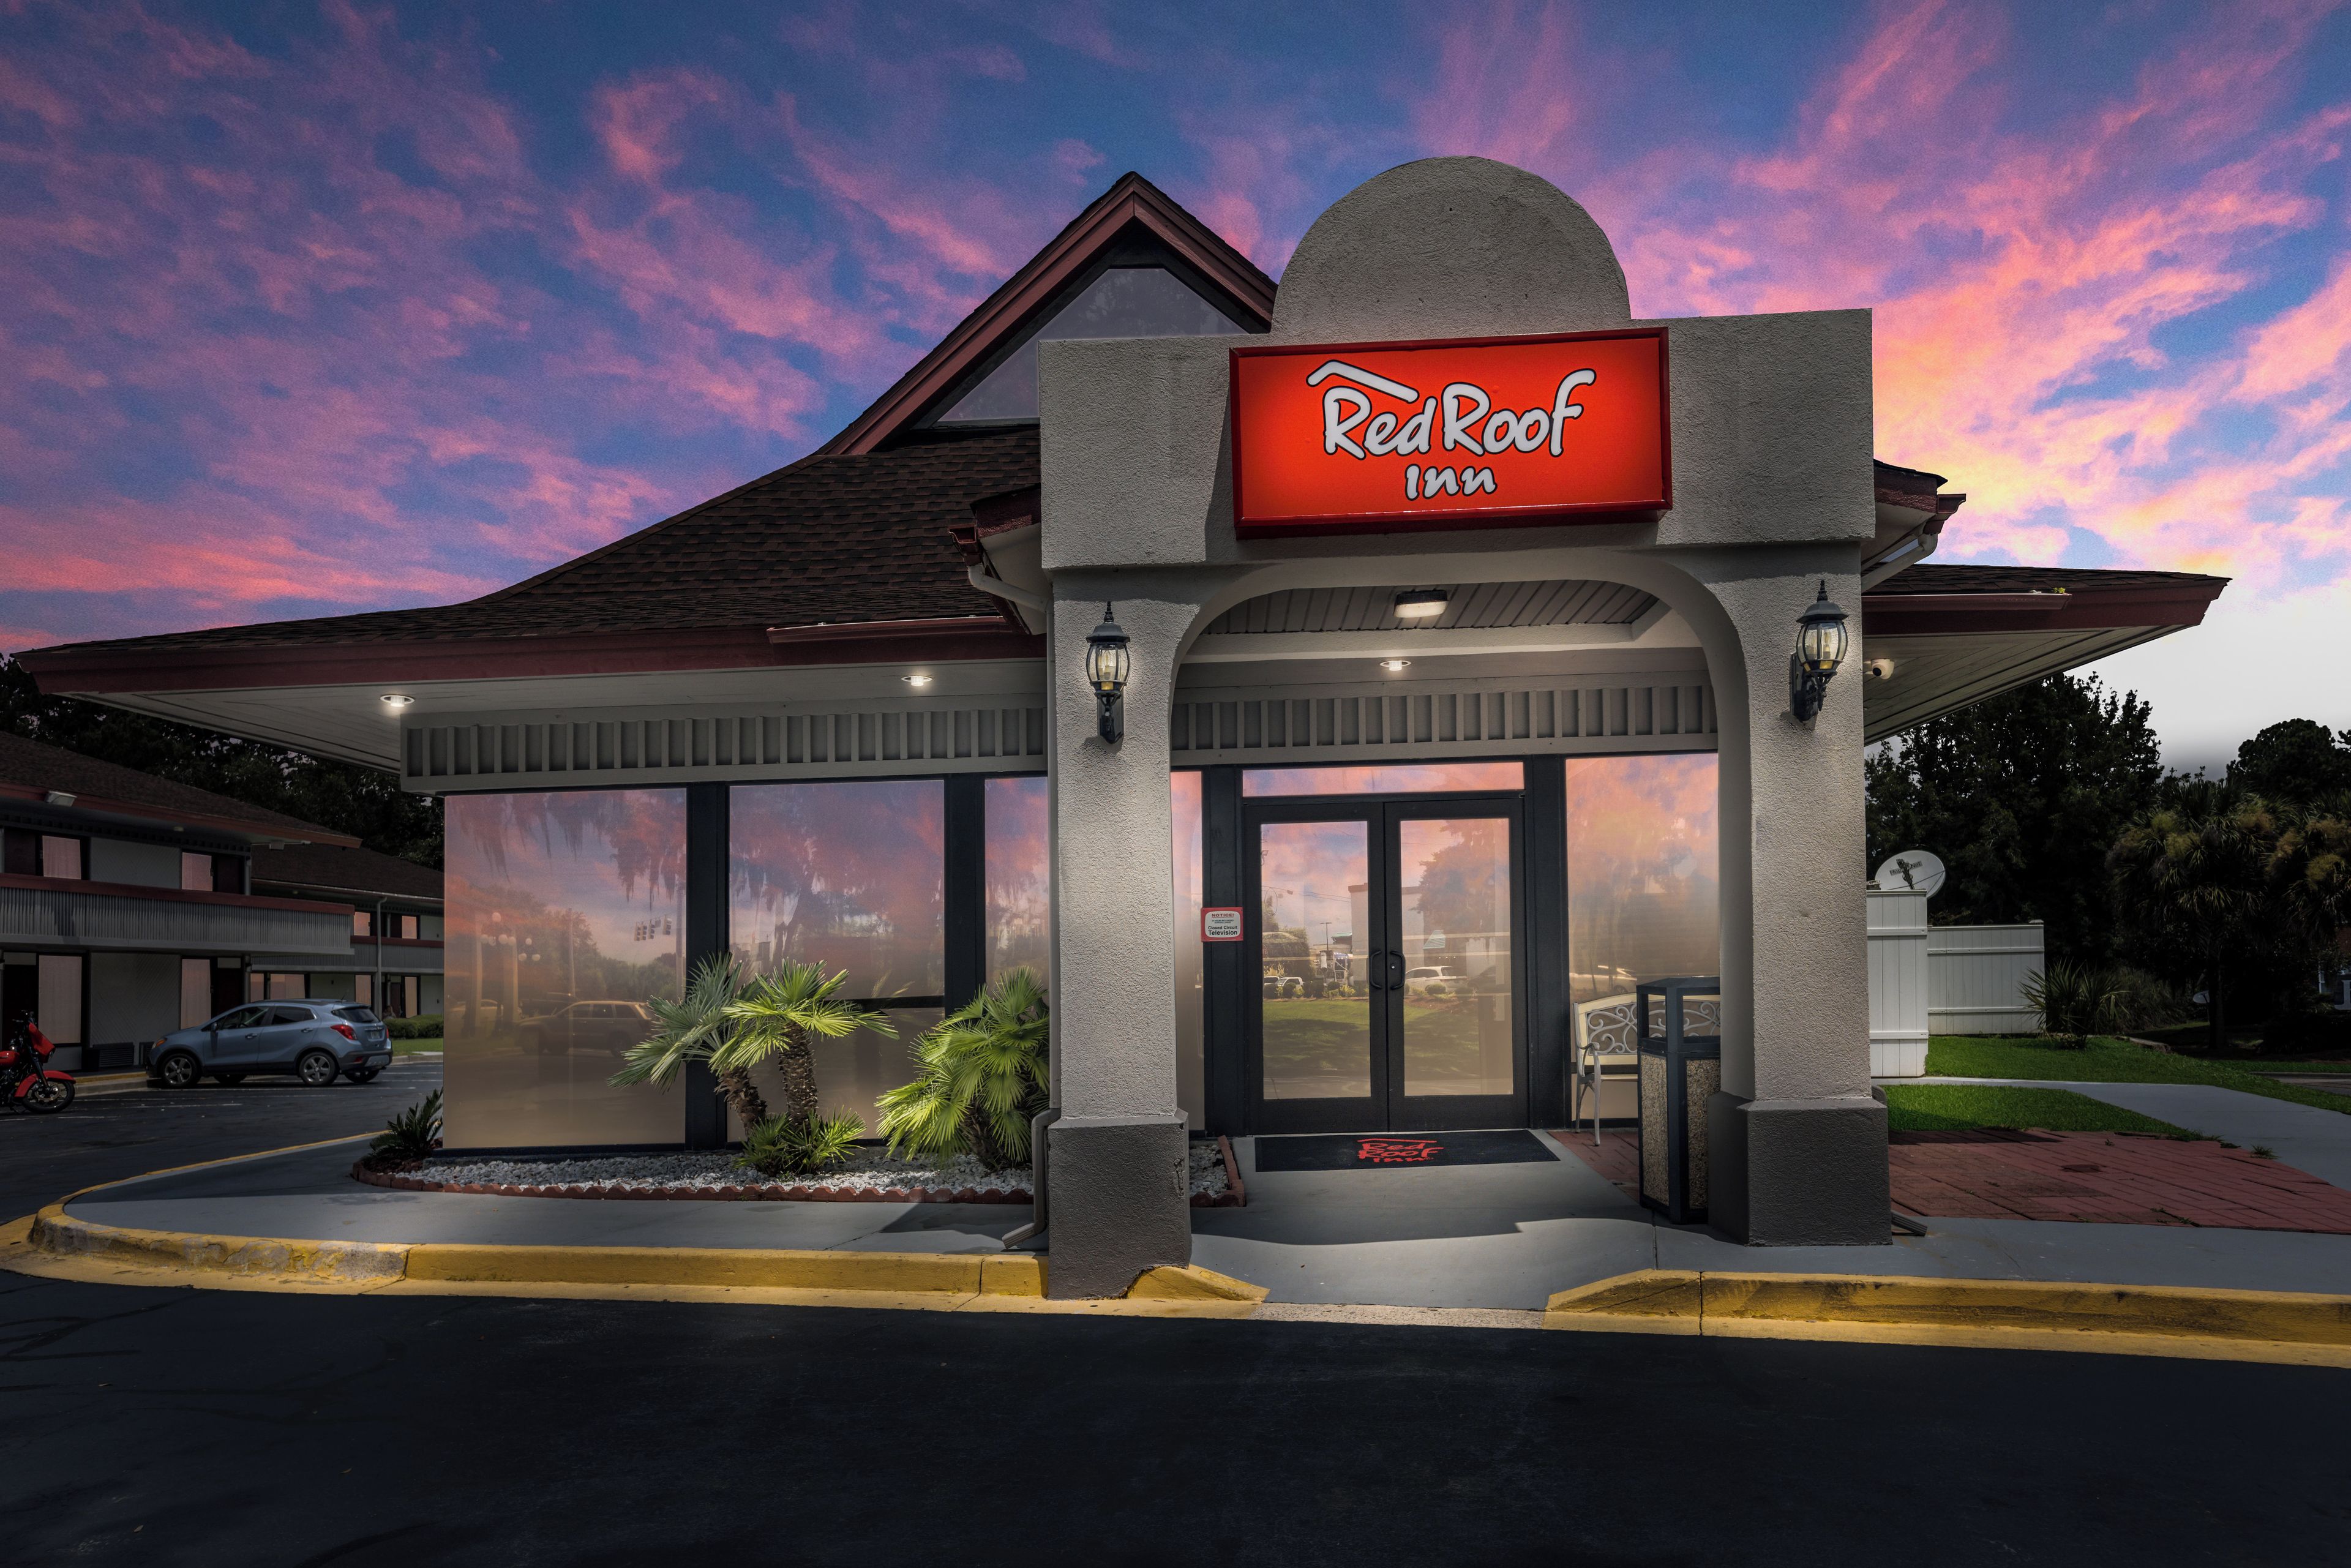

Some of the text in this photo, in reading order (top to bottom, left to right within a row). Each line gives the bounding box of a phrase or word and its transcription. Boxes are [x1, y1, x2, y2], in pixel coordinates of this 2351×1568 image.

[1322, 368, 1597, 460] Red Roof
[1357, 1147, 1444, 1159] Roof
